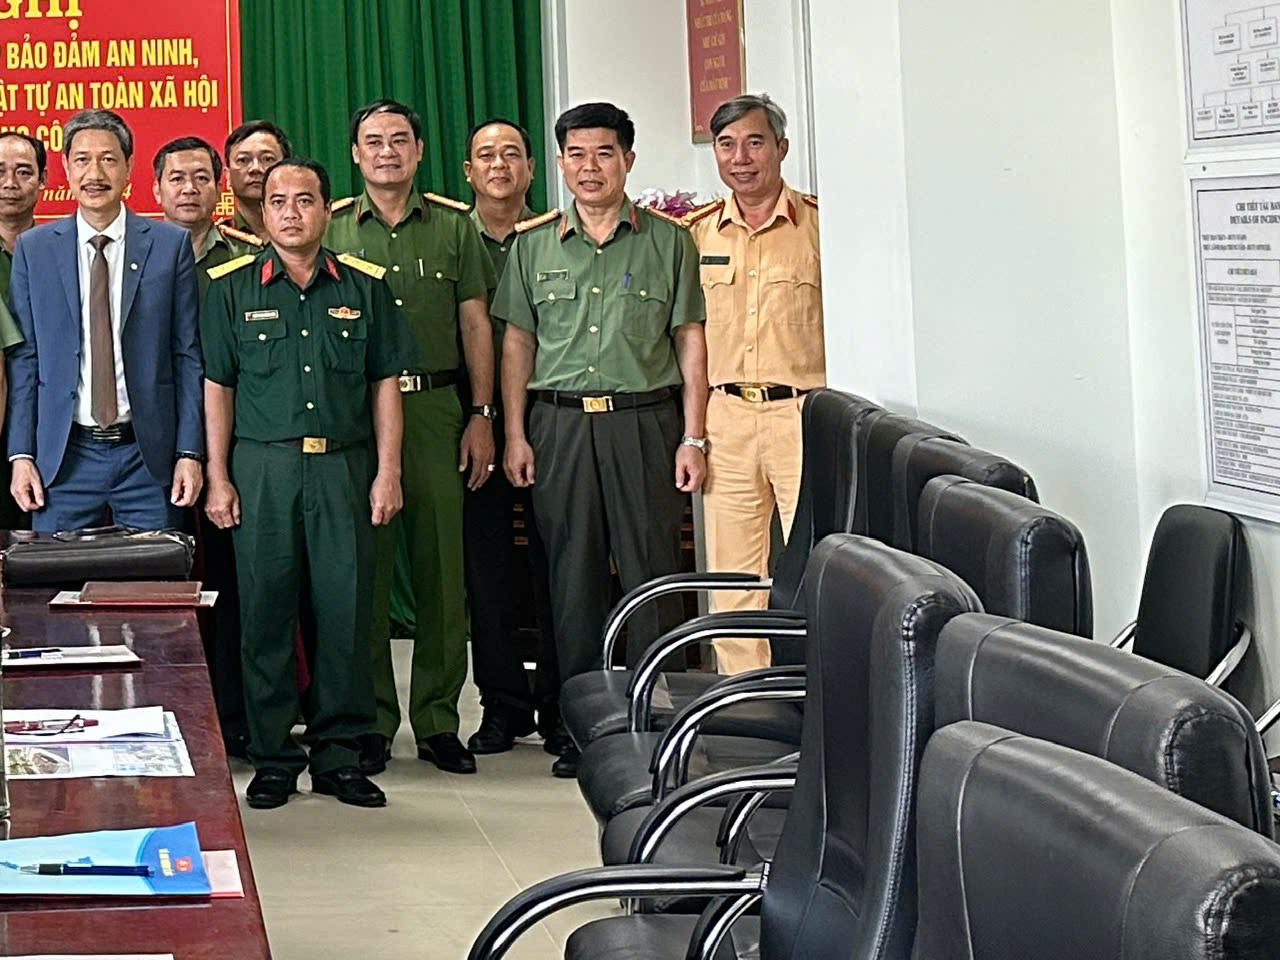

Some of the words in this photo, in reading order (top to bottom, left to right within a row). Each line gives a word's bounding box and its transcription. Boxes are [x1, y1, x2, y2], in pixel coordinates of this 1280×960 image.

[6, 33, 48, 70] BẢO
[53, 32, 101, 69] ĐẢM
[106, 40, 135, 68] AN
[141, 38, 200, 69] NINH,
[23, 80, 52, 117] TỰ
[55, 84, 85, 111] AN
[89, 74, 144, 110] TOÀN
[150, 75, 178, 108] XÃ
[183, 74, 219, 113] HỘI
[35, 119, 64, 153] CÔ
